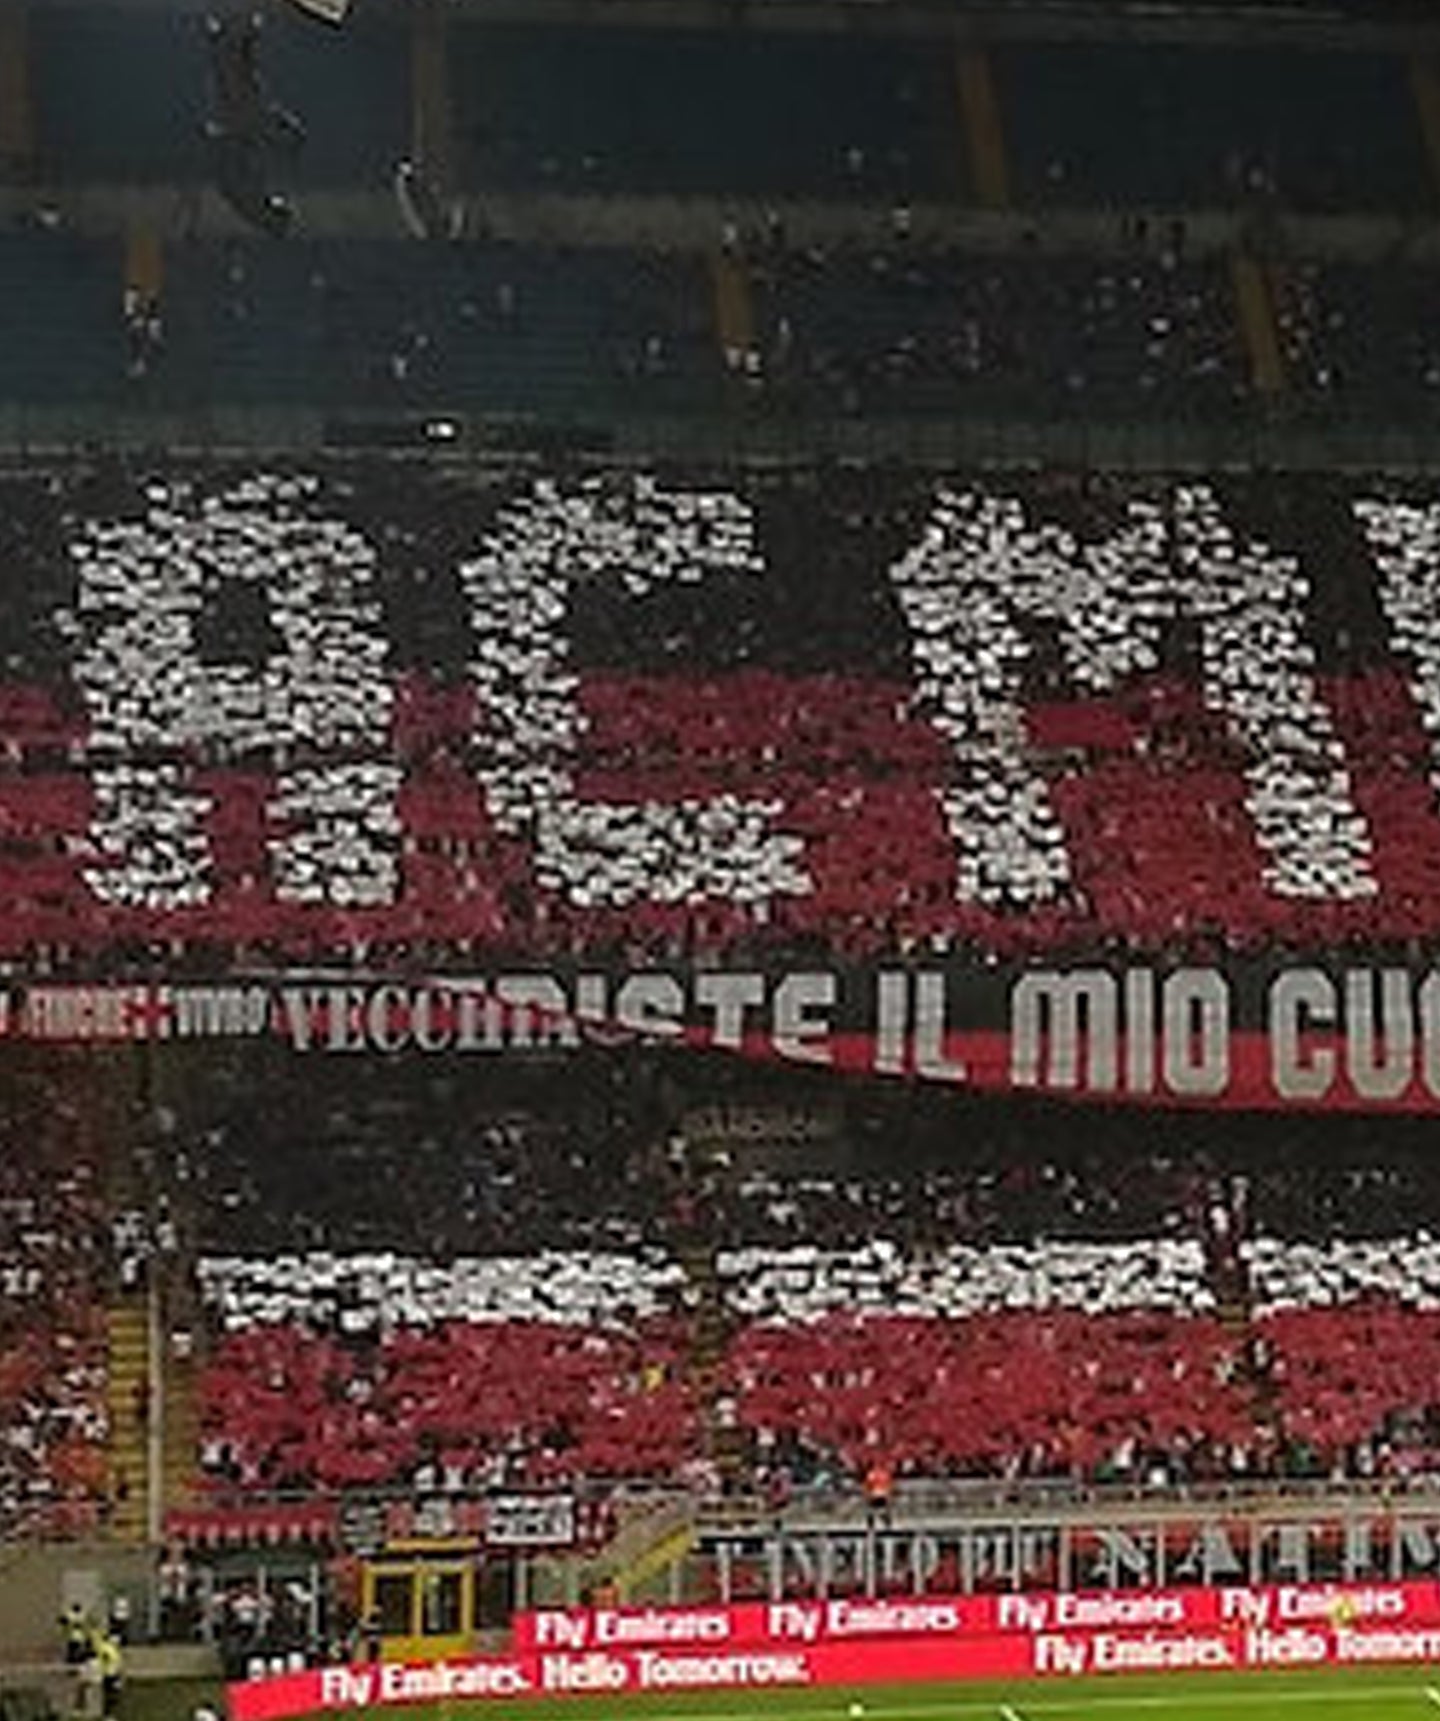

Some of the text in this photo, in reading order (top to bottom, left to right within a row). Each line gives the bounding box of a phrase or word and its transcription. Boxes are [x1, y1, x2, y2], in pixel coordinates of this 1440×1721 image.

[64, 473, 811, 906] AC
[875, 972, 966, 1080] IL
[1009, 967, 1230, 1094] MIO
[768, 1604, 820, 1639] Fly
[997, 1594, 1049, 1630] Fly
[1221, 1587, 1270, 1622] Fly
[536, 1610, 585, 1650] Fly
[1246, 1628, 1326, 1664] Hello
[543, 1651, 628, 1690] Hello
